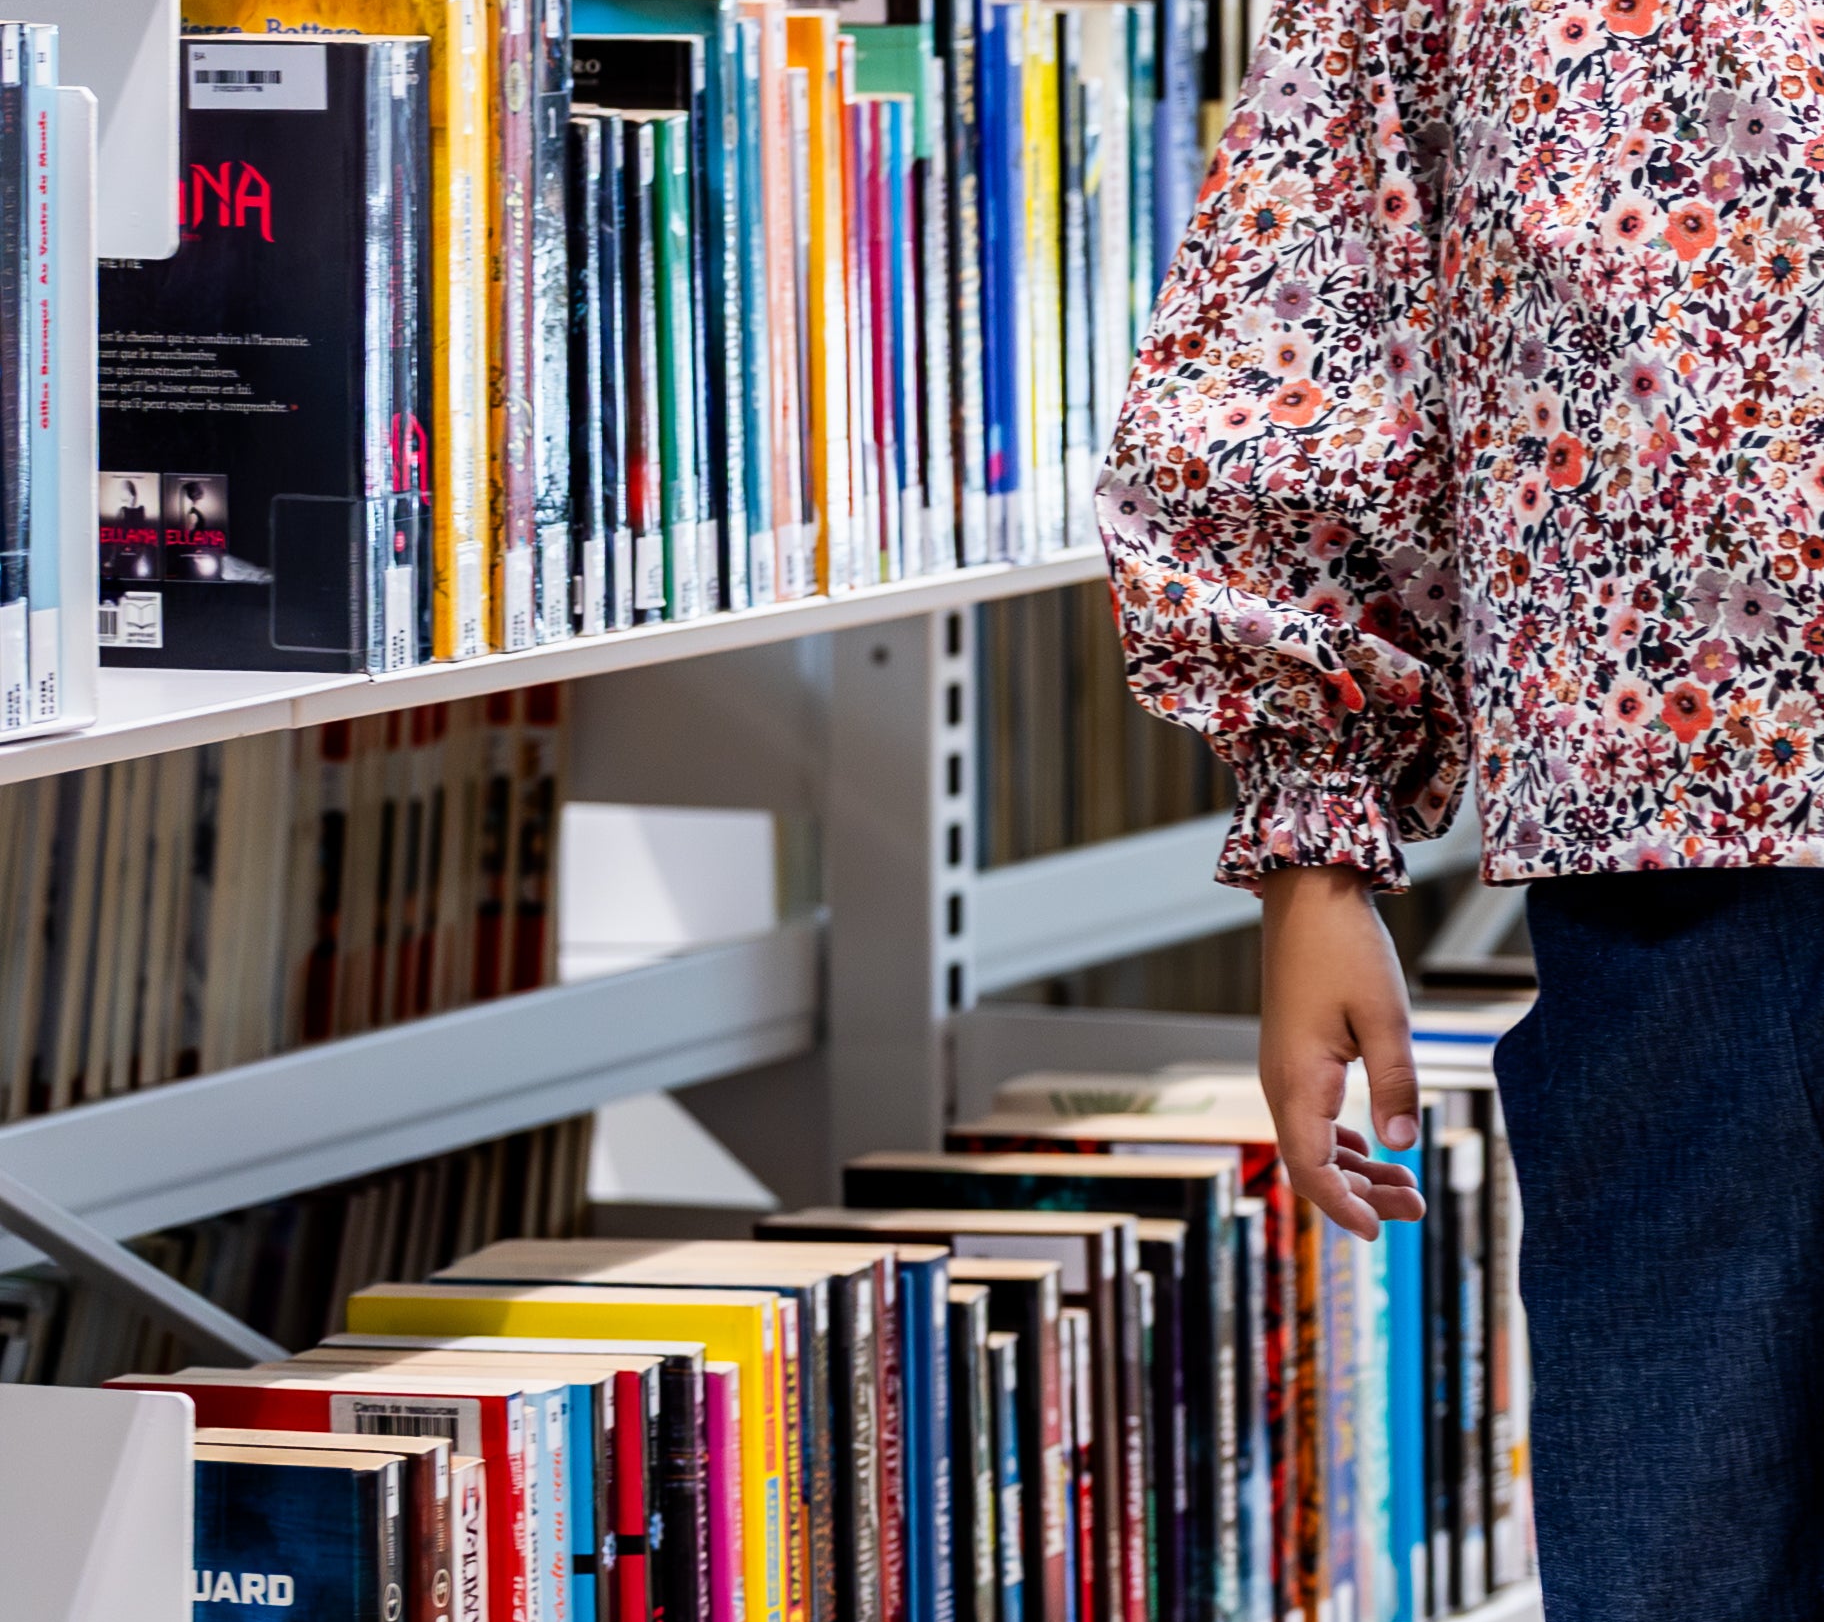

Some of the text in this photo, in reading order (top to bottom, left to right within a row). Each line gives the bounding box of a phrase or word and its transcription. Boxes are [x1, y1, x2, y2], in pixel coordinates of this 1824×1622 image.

[181, 17, 243, 35] ierre
[37, 111, 48, 167] Monde
[38, 175, 48, 195] du
[38, 202, 49, 255] Ventre
[39, 263, 49, 285] Au
[39, 382, 50, 428] Gilles
[389, 1404, 402, 1414] de
[553, 1512, 564, 1542] au
